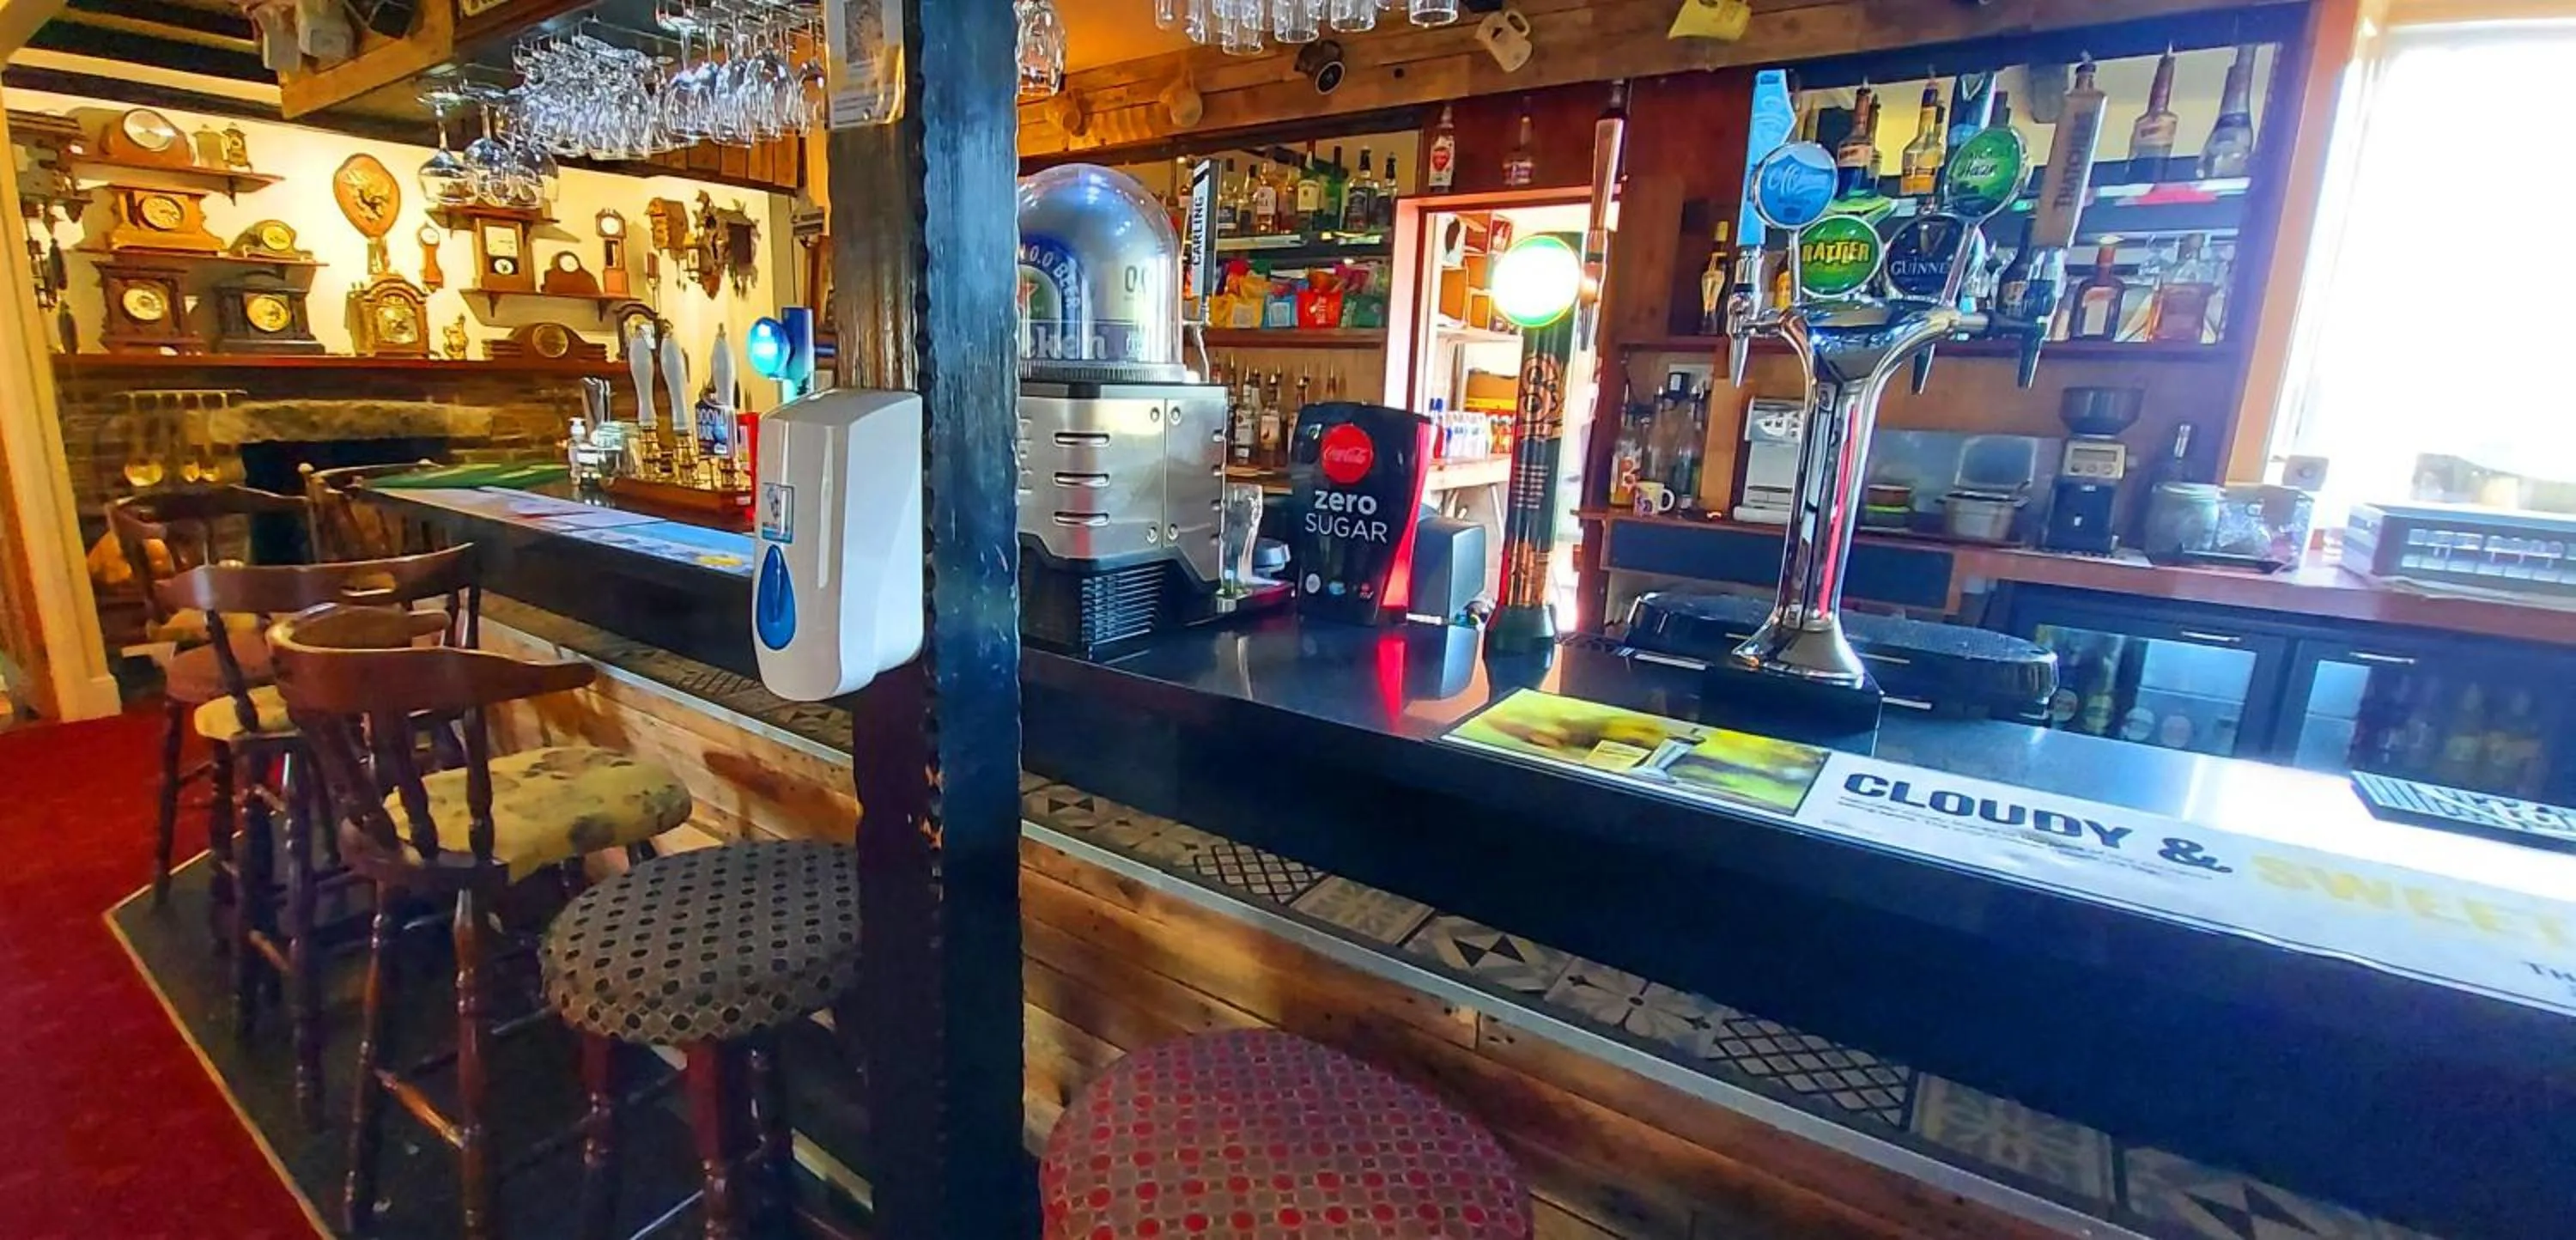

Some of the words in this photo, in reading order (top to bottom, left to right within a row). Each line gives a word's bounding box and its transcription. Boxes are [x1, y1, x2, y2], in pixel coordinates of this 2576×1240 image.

[1193, 196, 1204, 265] CARLING
[1891, 260, 1948, 277] GUINNE
[1315, 490, 1376, 514] zero
[1304, 513, 1388, 544] SUGAR
[1844, 774, 2133, 848] CLOUDY
[2157, 837, 2233, 873] &
